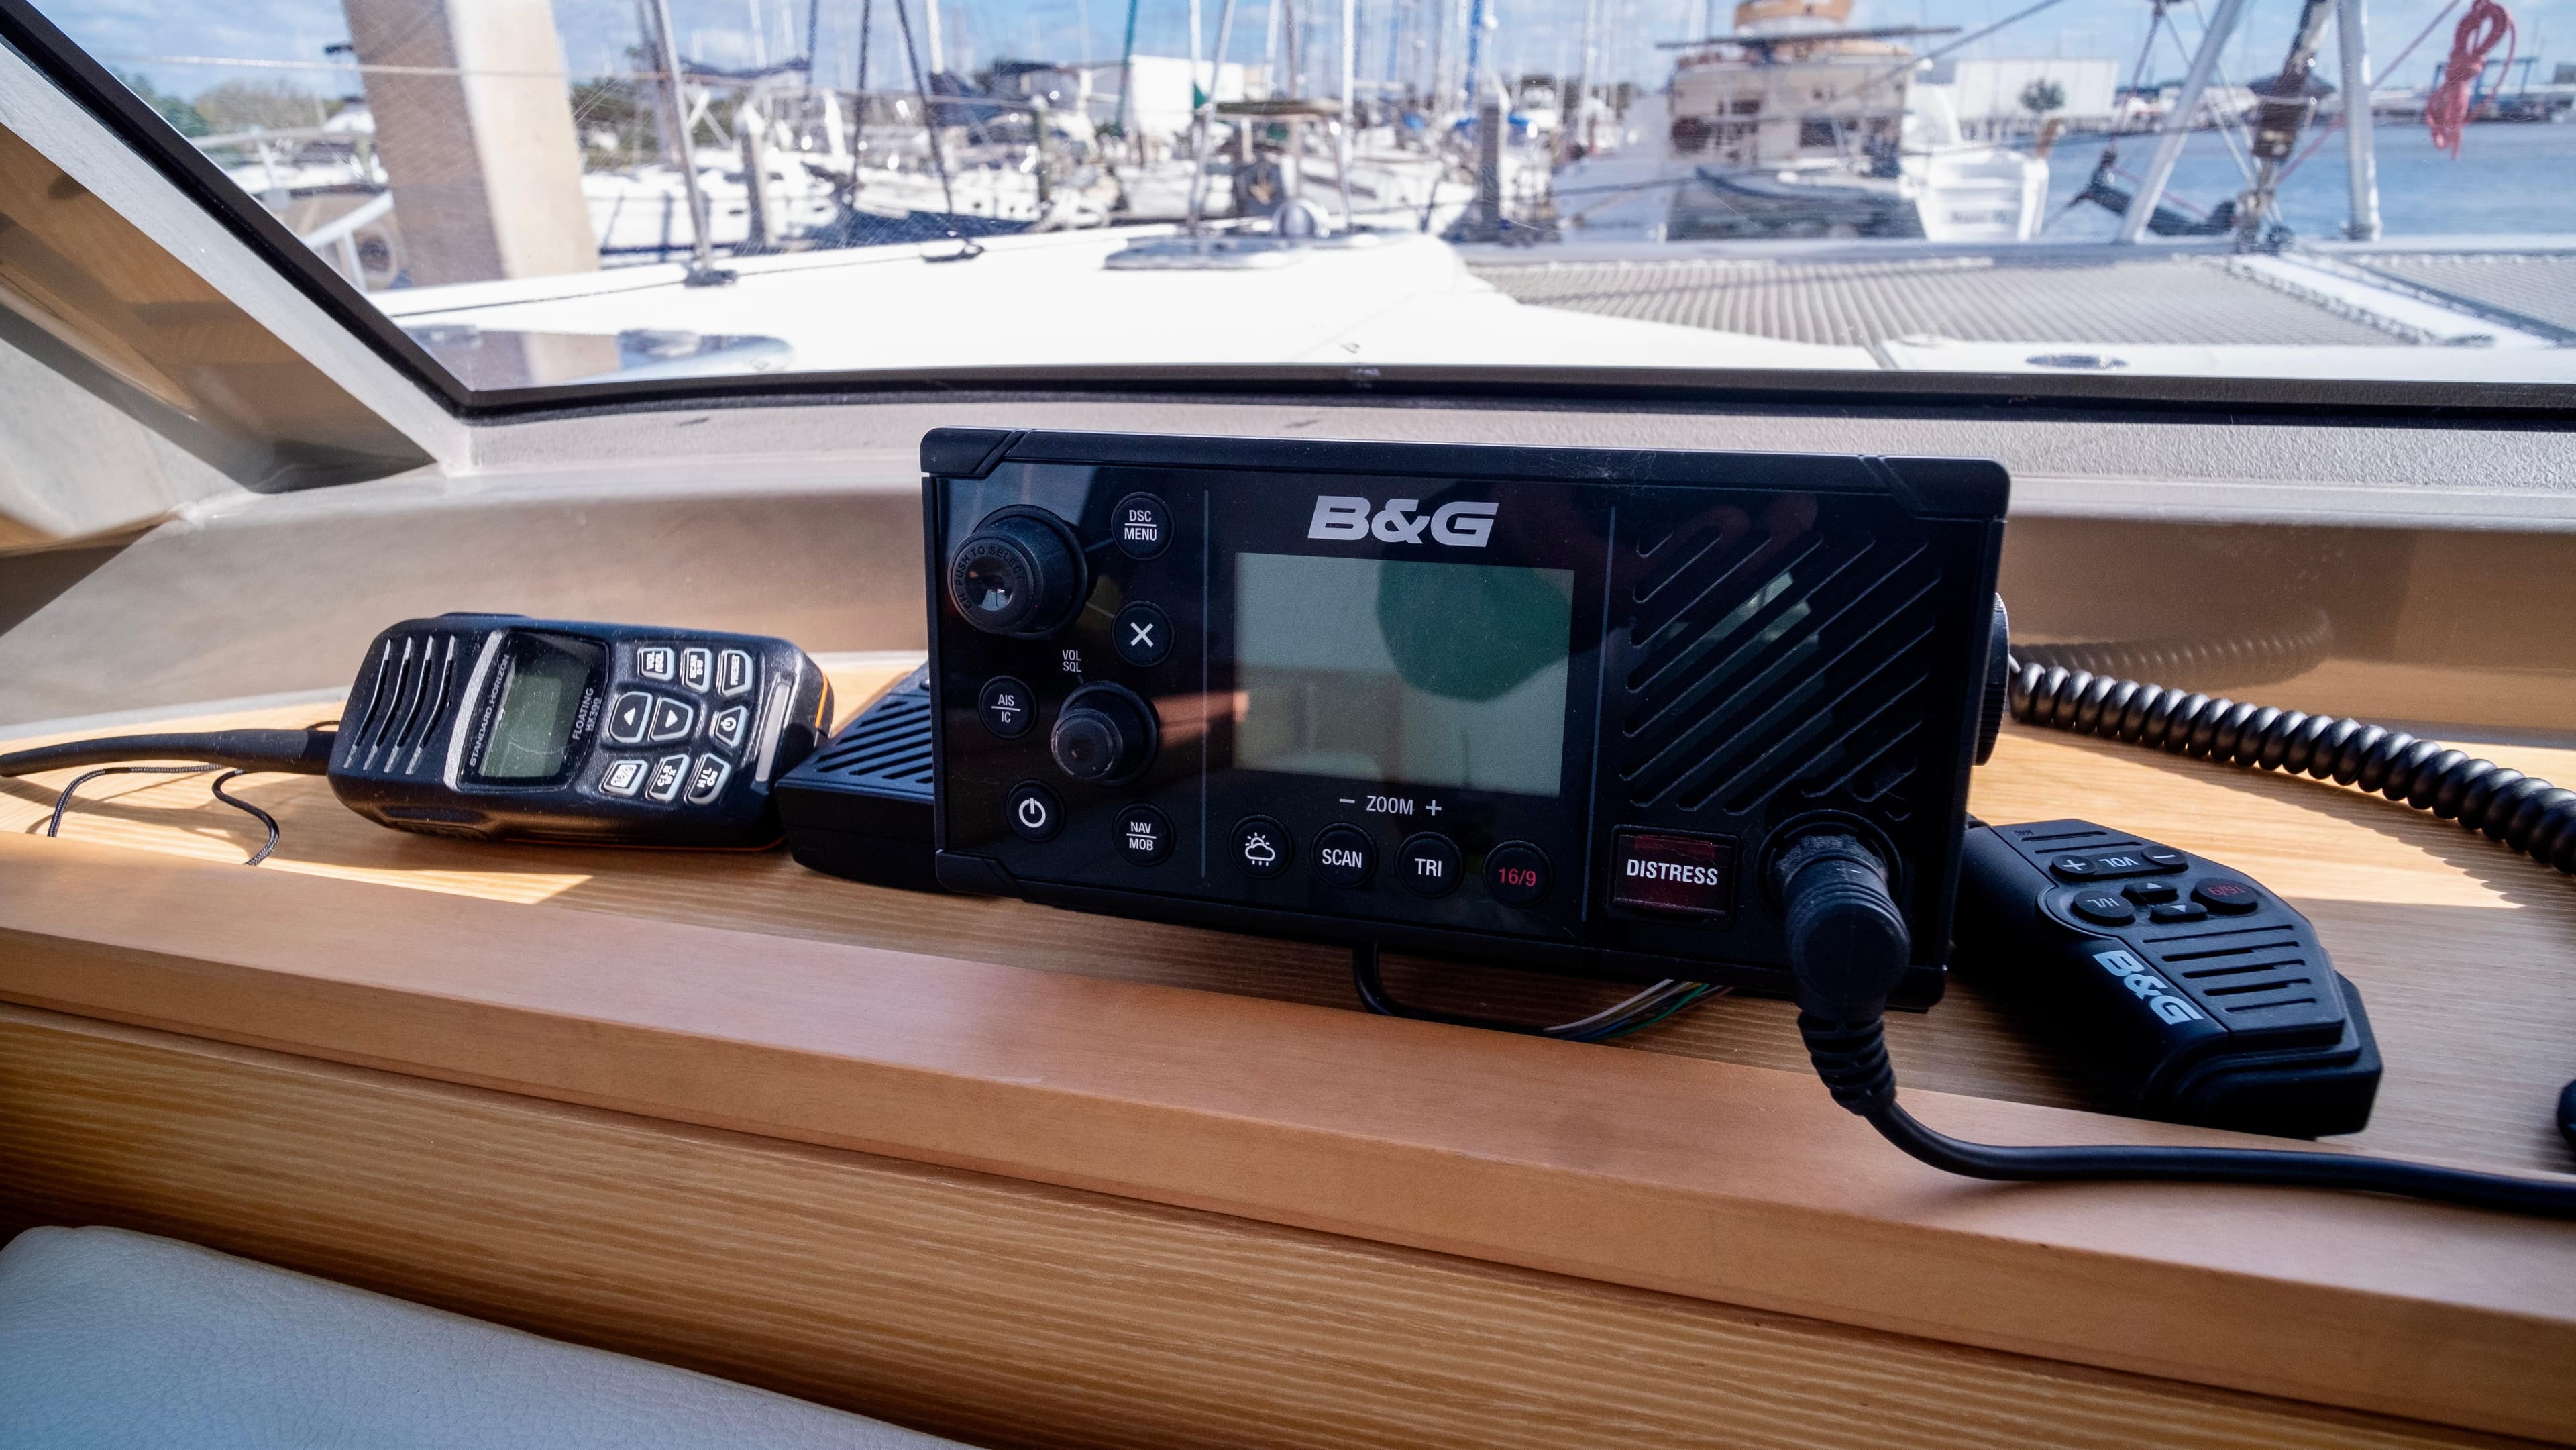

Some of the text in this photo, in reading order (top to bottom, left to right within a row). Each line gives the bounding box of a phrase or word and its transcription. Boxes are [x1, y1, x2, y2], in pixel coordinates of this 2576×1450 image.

[1128, 509, 1152, 522] DSC
[1307, 495, 1499, 547] B&G
[1124, 527, 1157, 541] MENU
[955, 554, 970, 586] PUSH
[971, 546, 985, 558] TO
[989, 546, 1024, 580] SELECT
[1062, 649, 1082, 662] VOL
[1063, 661, 1082, 672] SQL
[998, 694, 1015, 707] AIS
[470, 654, 510, 767] STANDARD HORIZON
[572, 687, 594, 740] FLOATING
[1000, 710, 1012, 723] IC
[614, 766, 633, 784] 16/9
[657, 765, 673, 787] CLR
[696, 767, 712, 788] H/L
[1366, 795, 1413, 815] ZOOM
[1130, 821, 1152, 834] NAV
[1128, 837, 1154, 851] MOB
[1322, 848, 1362, 868] SCAN
[2098, 856, 2140, 868] VOL
[1414, 858, 1442, 877] TRI
[1627, 858, 1719, 886] DISTRESS
[1498, 867, 1538, 887] 16/9
[2207, 884, 2246, 895] 16/9
[2087, 898, 2121, 908] H/L
[2093, 949, 2204, 1025] B&G
